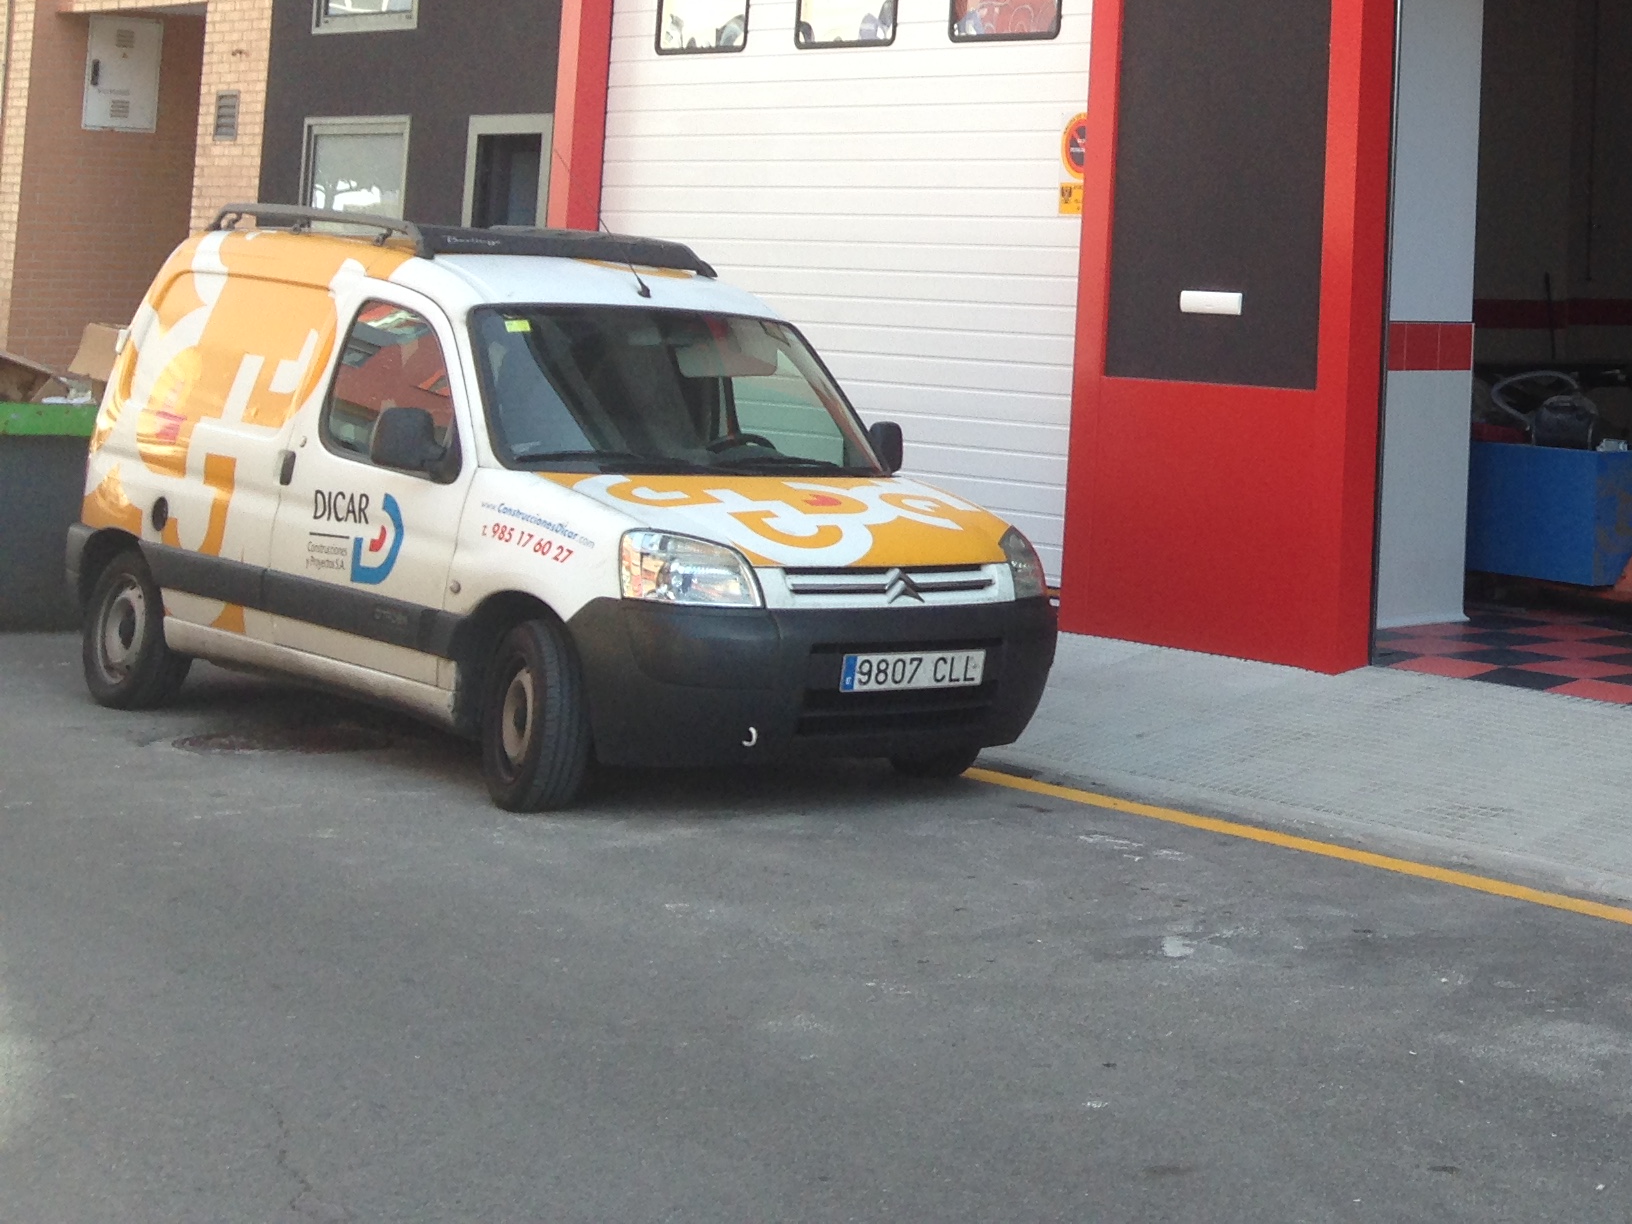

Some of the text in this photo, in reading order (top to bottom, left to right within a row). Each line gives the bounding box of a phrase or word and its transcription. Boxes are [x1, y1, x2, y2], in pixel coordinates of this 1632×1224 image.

[312, 489, 370, 525] DICAR
[491, 522, 515, 543] 985
[516, 530, 534, 548] 17
[533, 538, 553, 556] 60
[552, 545, 574, 564] 27
[857, 655, 975, 686] 9807 CLL
